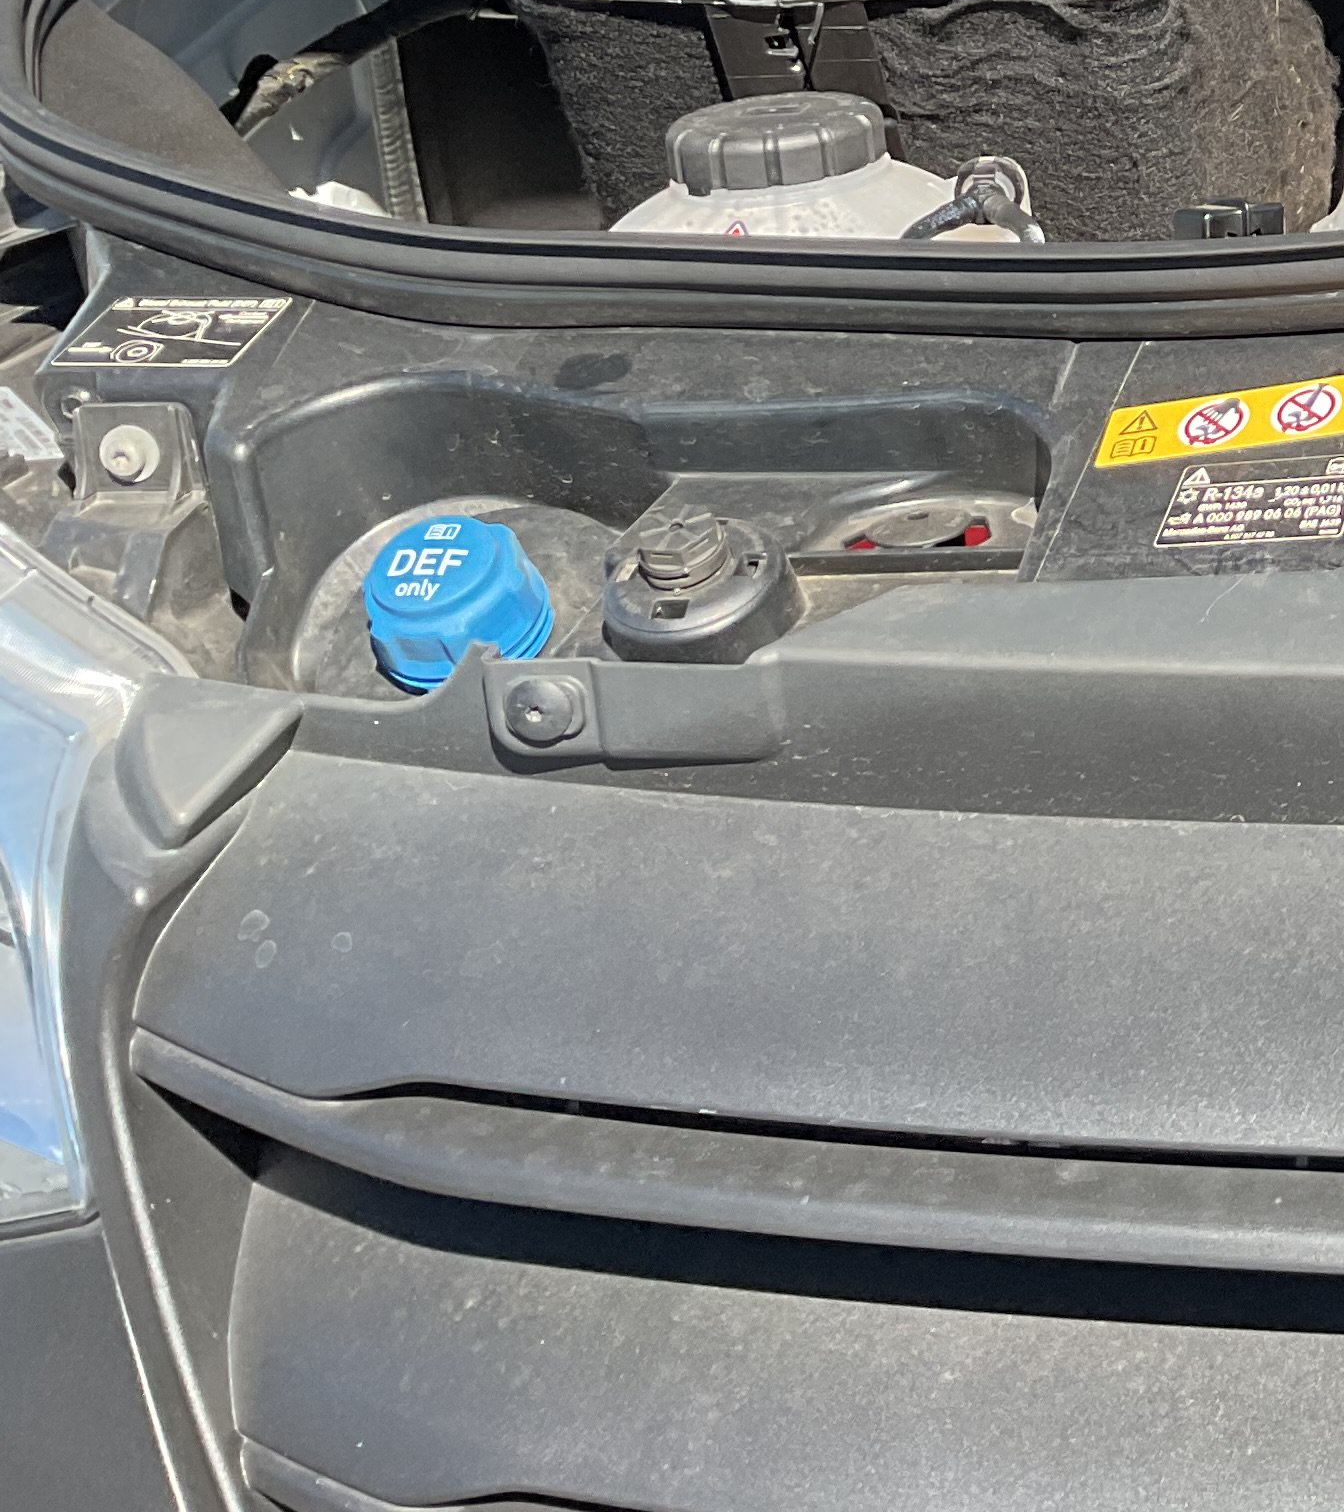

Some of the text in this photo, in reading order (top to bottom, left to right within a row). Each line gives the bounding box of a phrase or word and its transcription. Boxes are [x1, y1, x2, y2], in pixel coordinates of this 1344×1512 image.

[1202, 485, 1264, 501] R-134a
[1193, 504, 1341, 523] A 000 989 06 06 (PAG)
[387, 548, 469, 577] DEF
[394, 579, 441, 601] only
